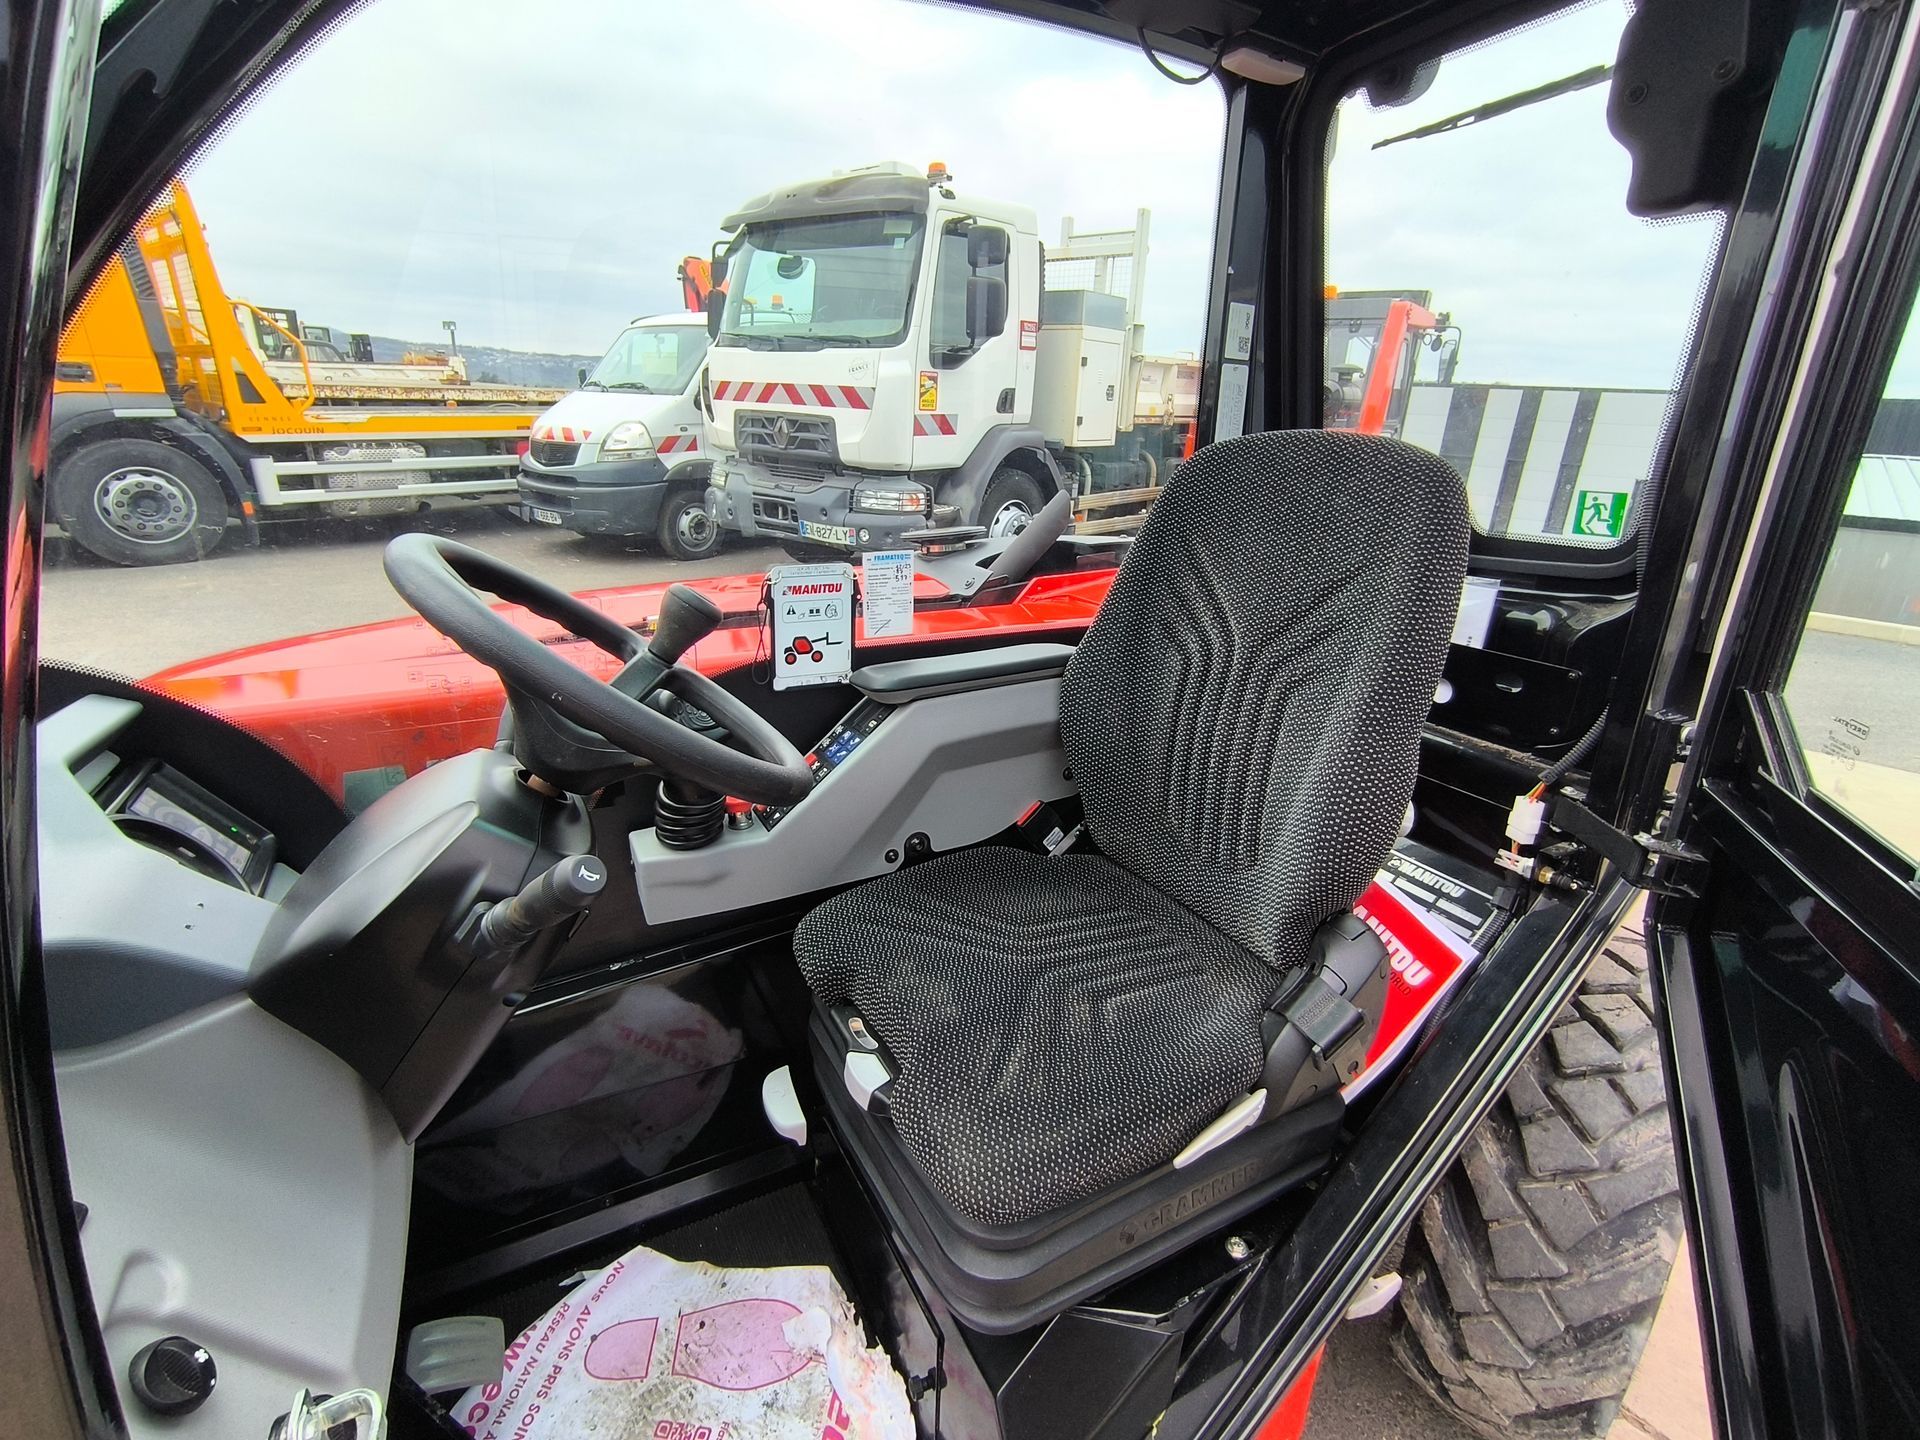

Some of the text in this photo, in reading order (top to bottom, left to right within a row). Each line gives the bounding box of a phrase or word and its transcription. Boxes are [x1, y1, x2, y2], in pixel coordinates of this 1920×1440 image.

[791, 583, 843, 596] MANITOU
[1398, 860, 1466, 898] MANITOU
[1353, 903, 1433, 987] ANITOU
[1390, 971, 1412, 996] ORLD
[1143, 1160, 1261, 1232] GRAMMER
[592, 1261, 625, 1302] NOUS
[535, 1302, 570, 1354] RÉSEAU
[558, 1305, 591, 1361] AVONS
[491, 1356, 539, 1426] NATIONAL
[536, 1364, 562, 1399] PRIS
